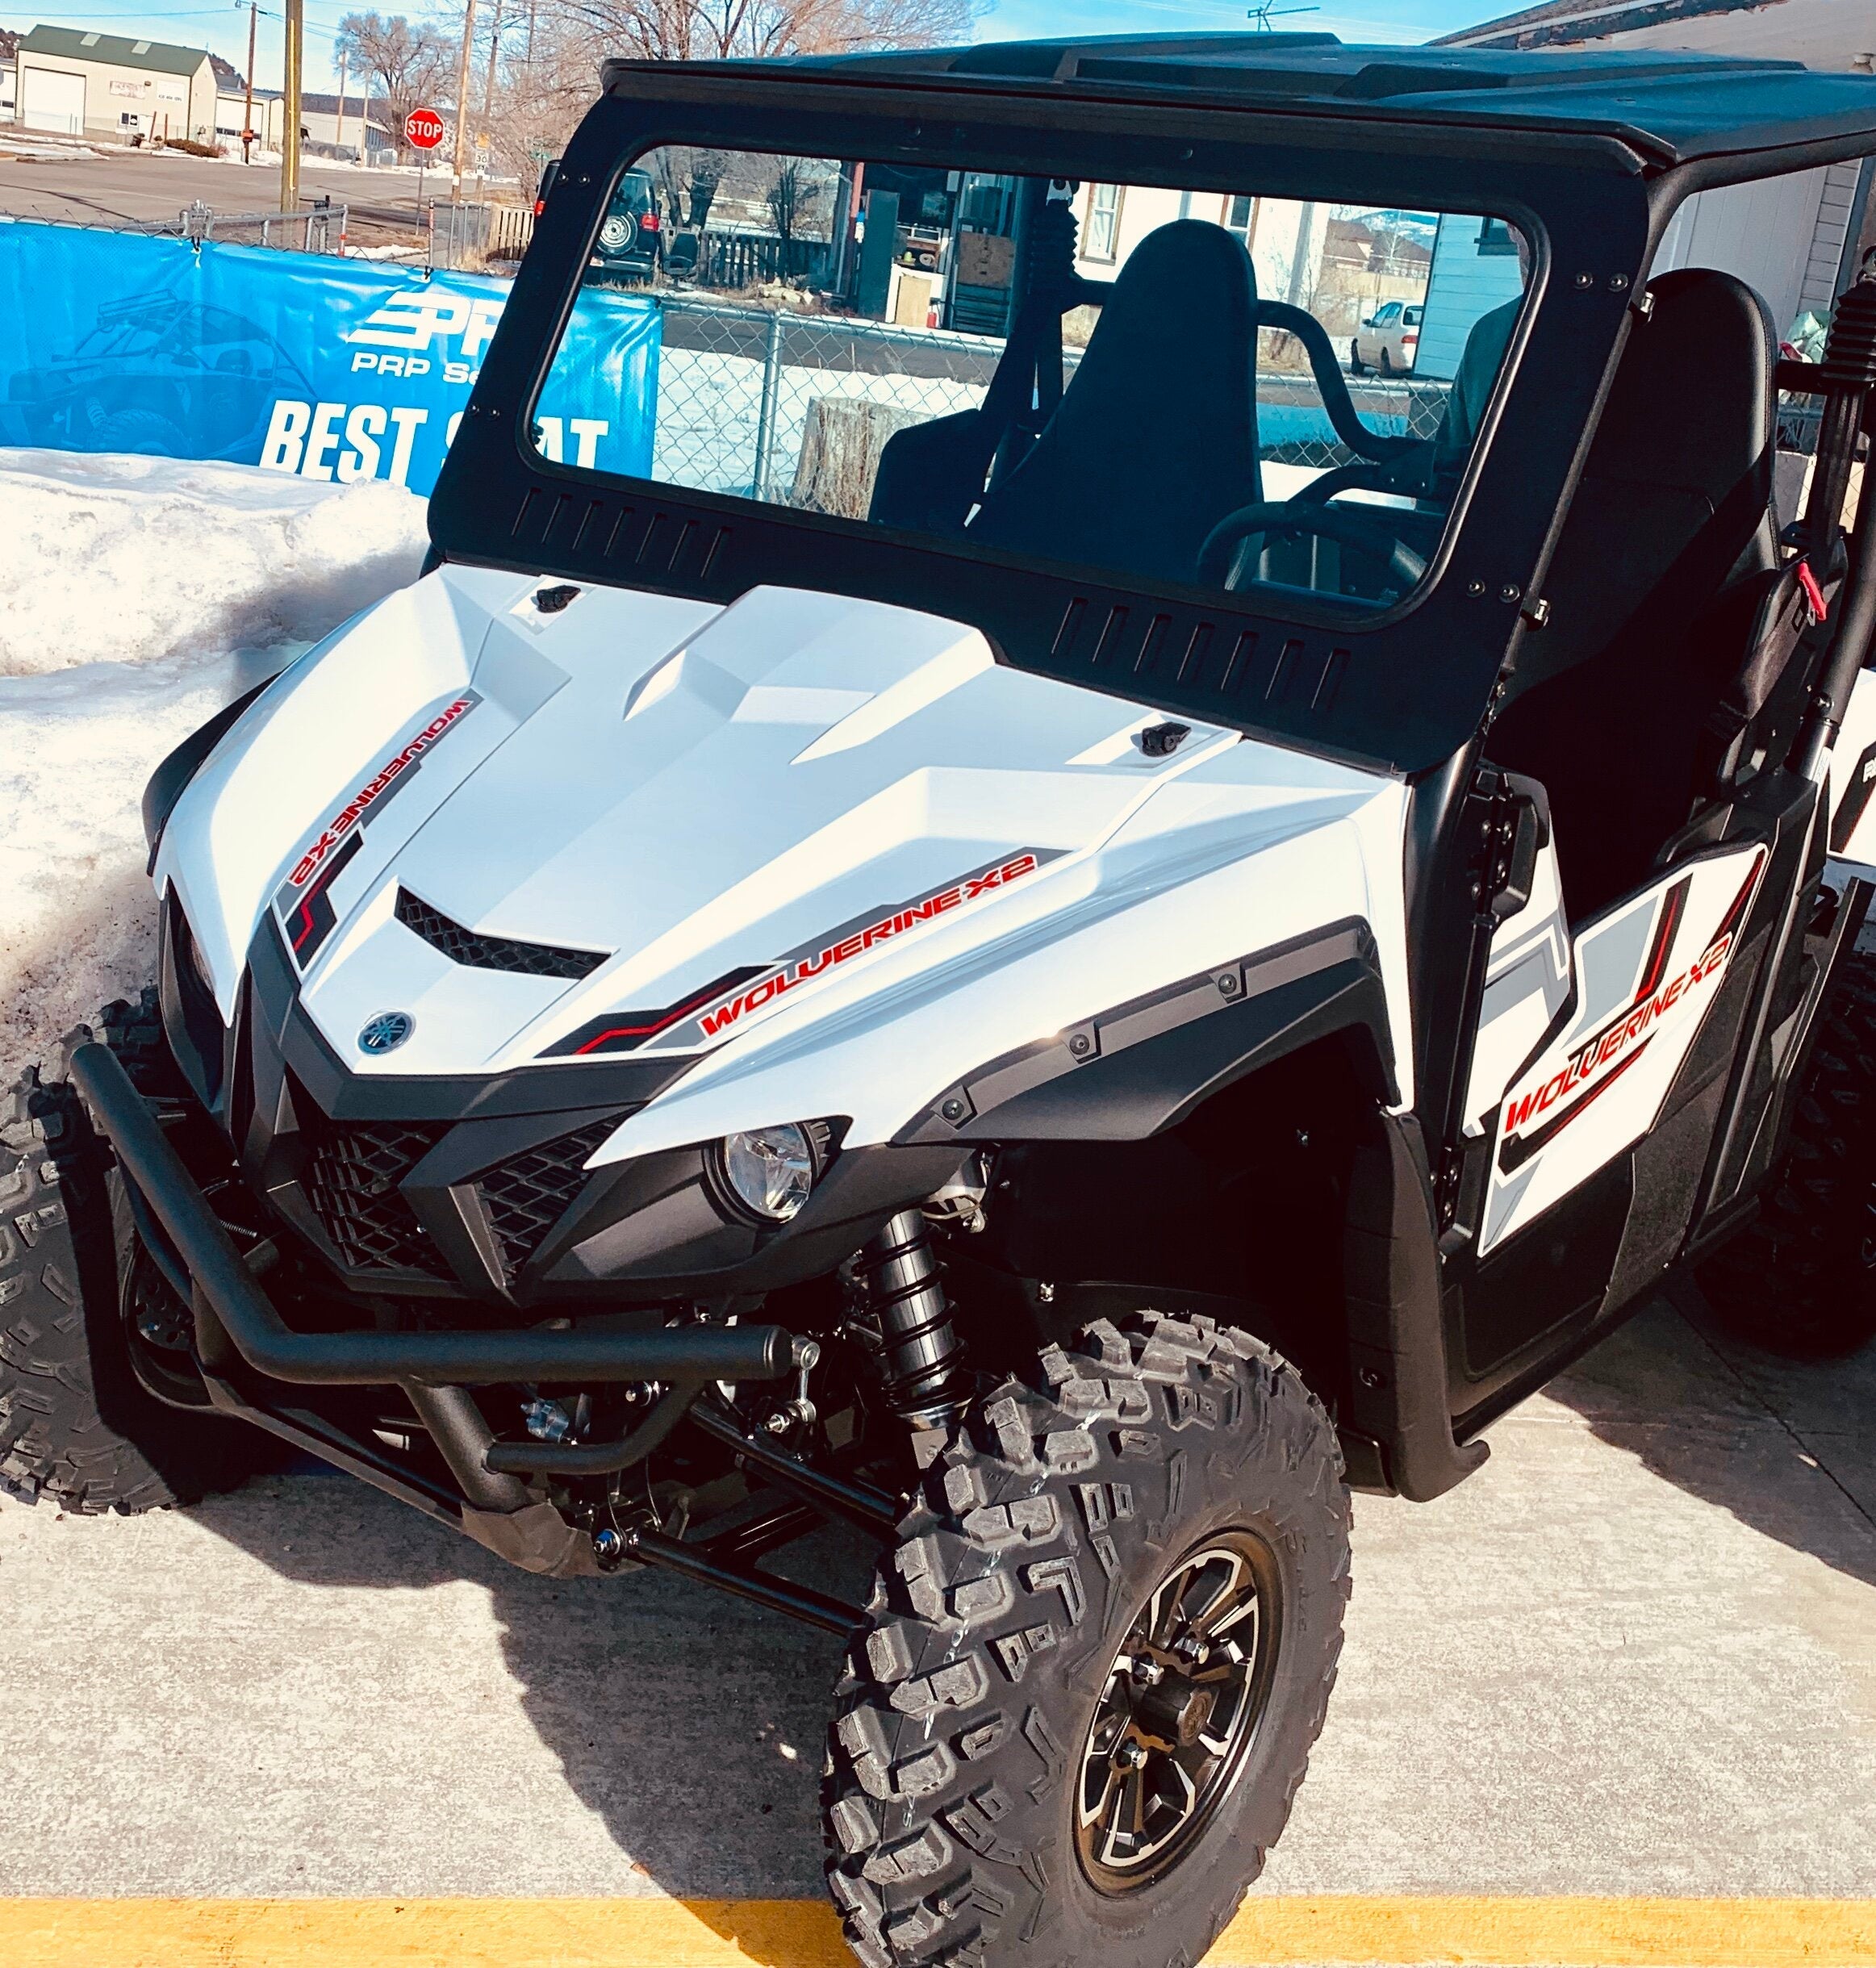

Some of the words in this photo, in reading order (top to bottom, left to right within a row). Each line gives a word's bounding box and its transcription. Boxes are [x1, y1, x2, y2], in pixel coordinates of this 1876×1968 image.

[407, 119, 442, 138] STOP
[476, 155, 487, 163] 30
[350, 352, 431, 378] PRP
[259, 400, 428, 486] BEST
